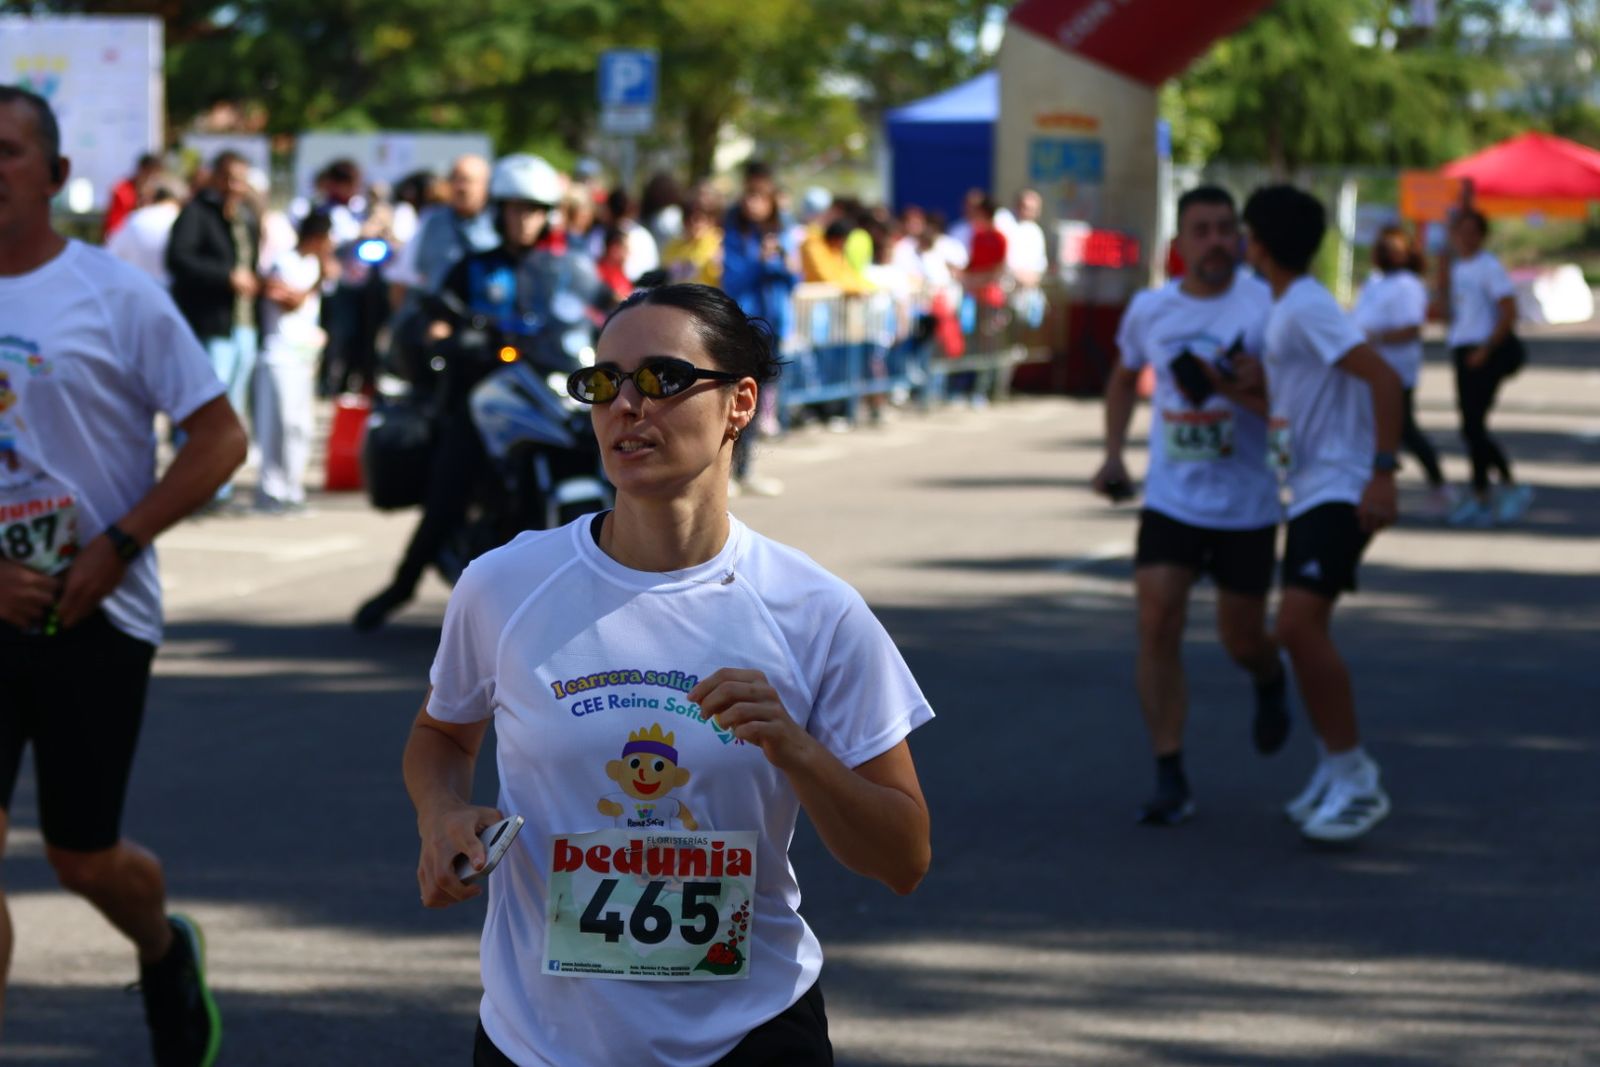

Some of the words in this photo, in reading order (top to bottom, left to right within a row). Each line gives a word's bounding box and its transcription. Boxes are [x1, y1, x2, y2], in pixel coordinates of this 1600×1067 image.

[610, 54, 643, 101] P
[0, 495, 73, 523] unia
[6, 513, 58, 559] 87
[551, 679, 567, 699] I
[564, 669, 643, 695] carrera
[643, 669, 700, 694] solid
[571, 696, 605, 717] CEE
[608, 693, 659, 710] Reina
[553, 838, 753, 878] bedunia
[579, 878, 722, 946] 465
